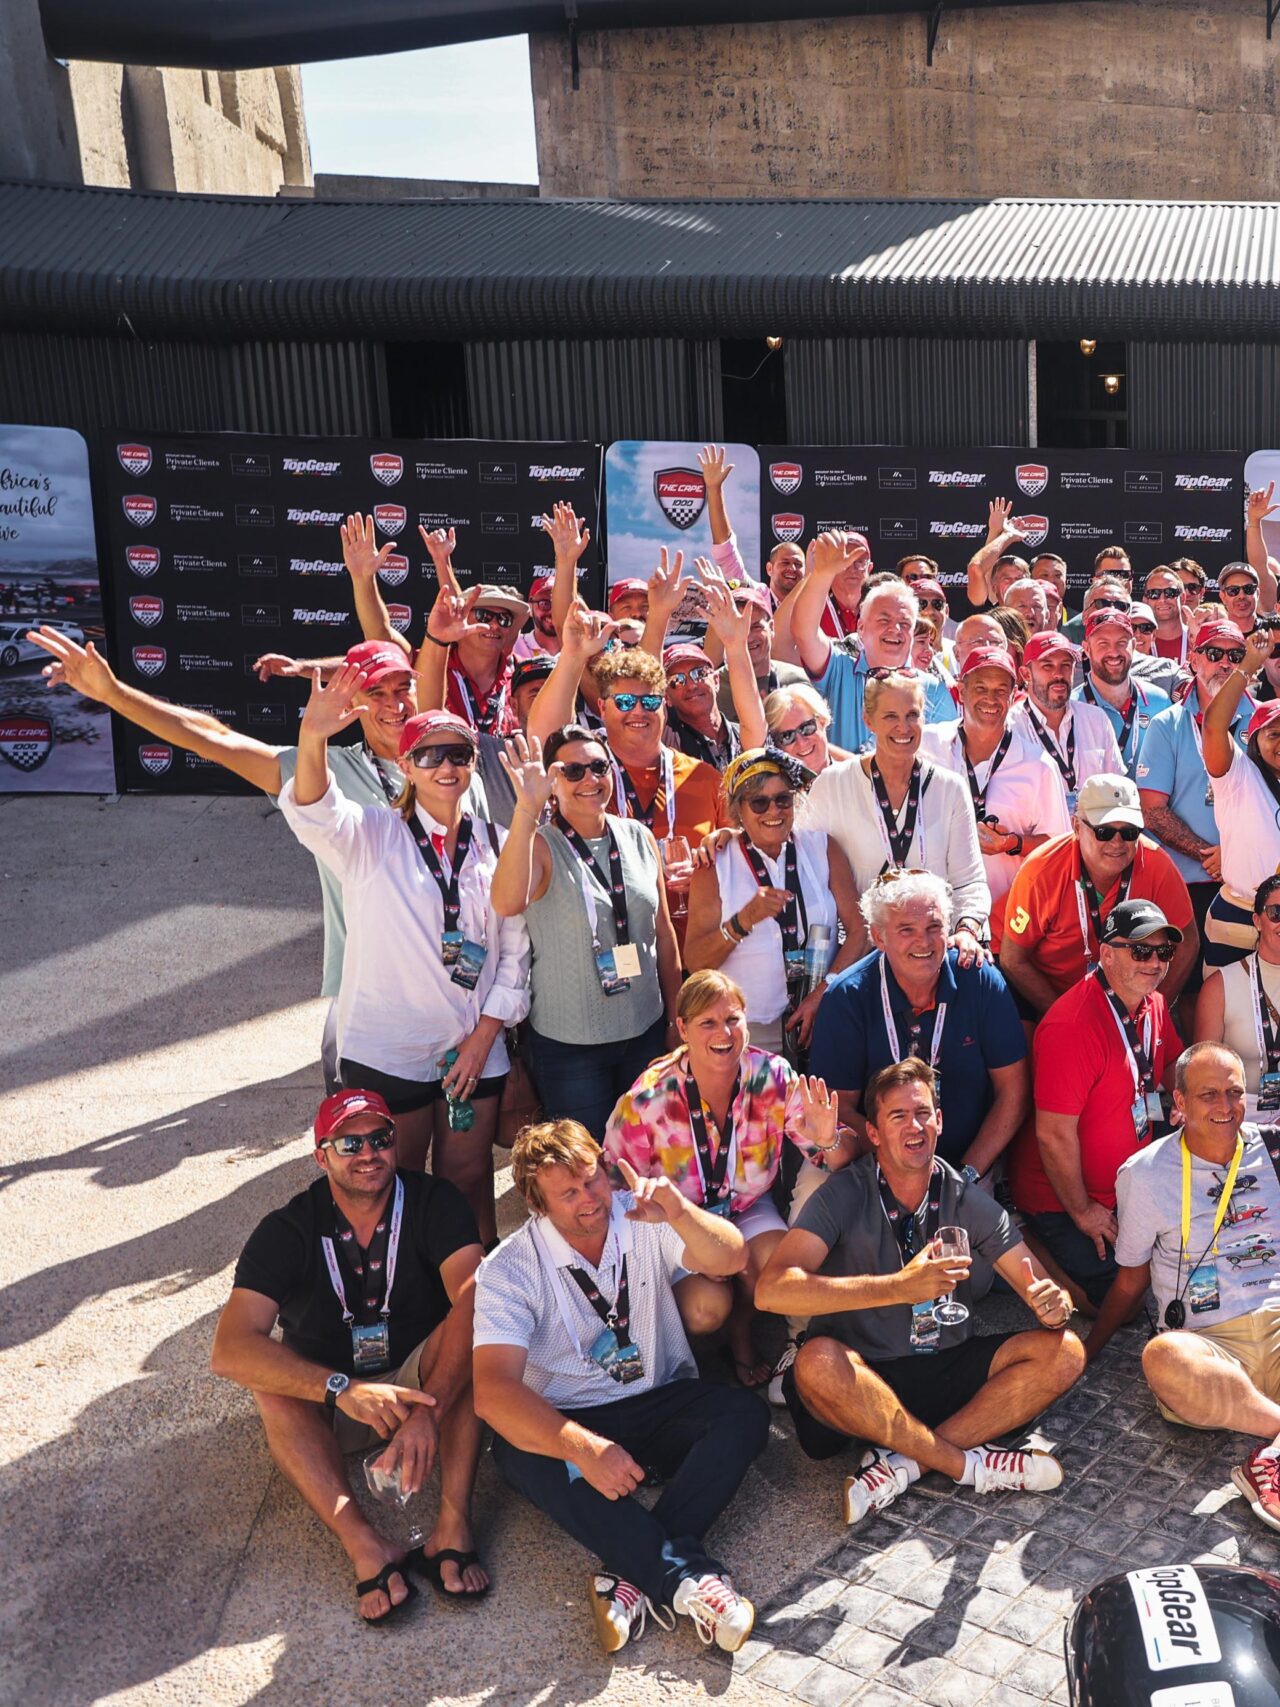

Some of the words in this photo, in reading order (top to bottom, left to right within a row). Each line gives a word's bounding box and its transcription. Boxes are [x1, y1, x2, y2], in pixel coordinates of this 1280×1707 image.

[166, 457, 192, 465] Private
[194, 458, 220, 466] Clients
[282, 458, 340, 473] TopGear
[528, 465, 585, 479] TopGear
[928, 471, 986, 485] TopGear
[678, 484, 704, 493] CAPE
[1175, 475, 1232, 488] TopGear
[170, 508, 197, 516] Private
[198, 509, 224, 517] Clients
[287, 508, 344, 523] TopGear
[929, 521, 986, 535] TopGear
[1175, 525, 1232, 539] TopGear
[290, 559, 346, 573] TopGear
[533, 565, 587, 577] Topar
[937, 572, 968, 585] opGe
[293, 608, 349, 622] TopGear
[0, 728, 17, 737] THE
[1010, 907, 1030, 934] 3
